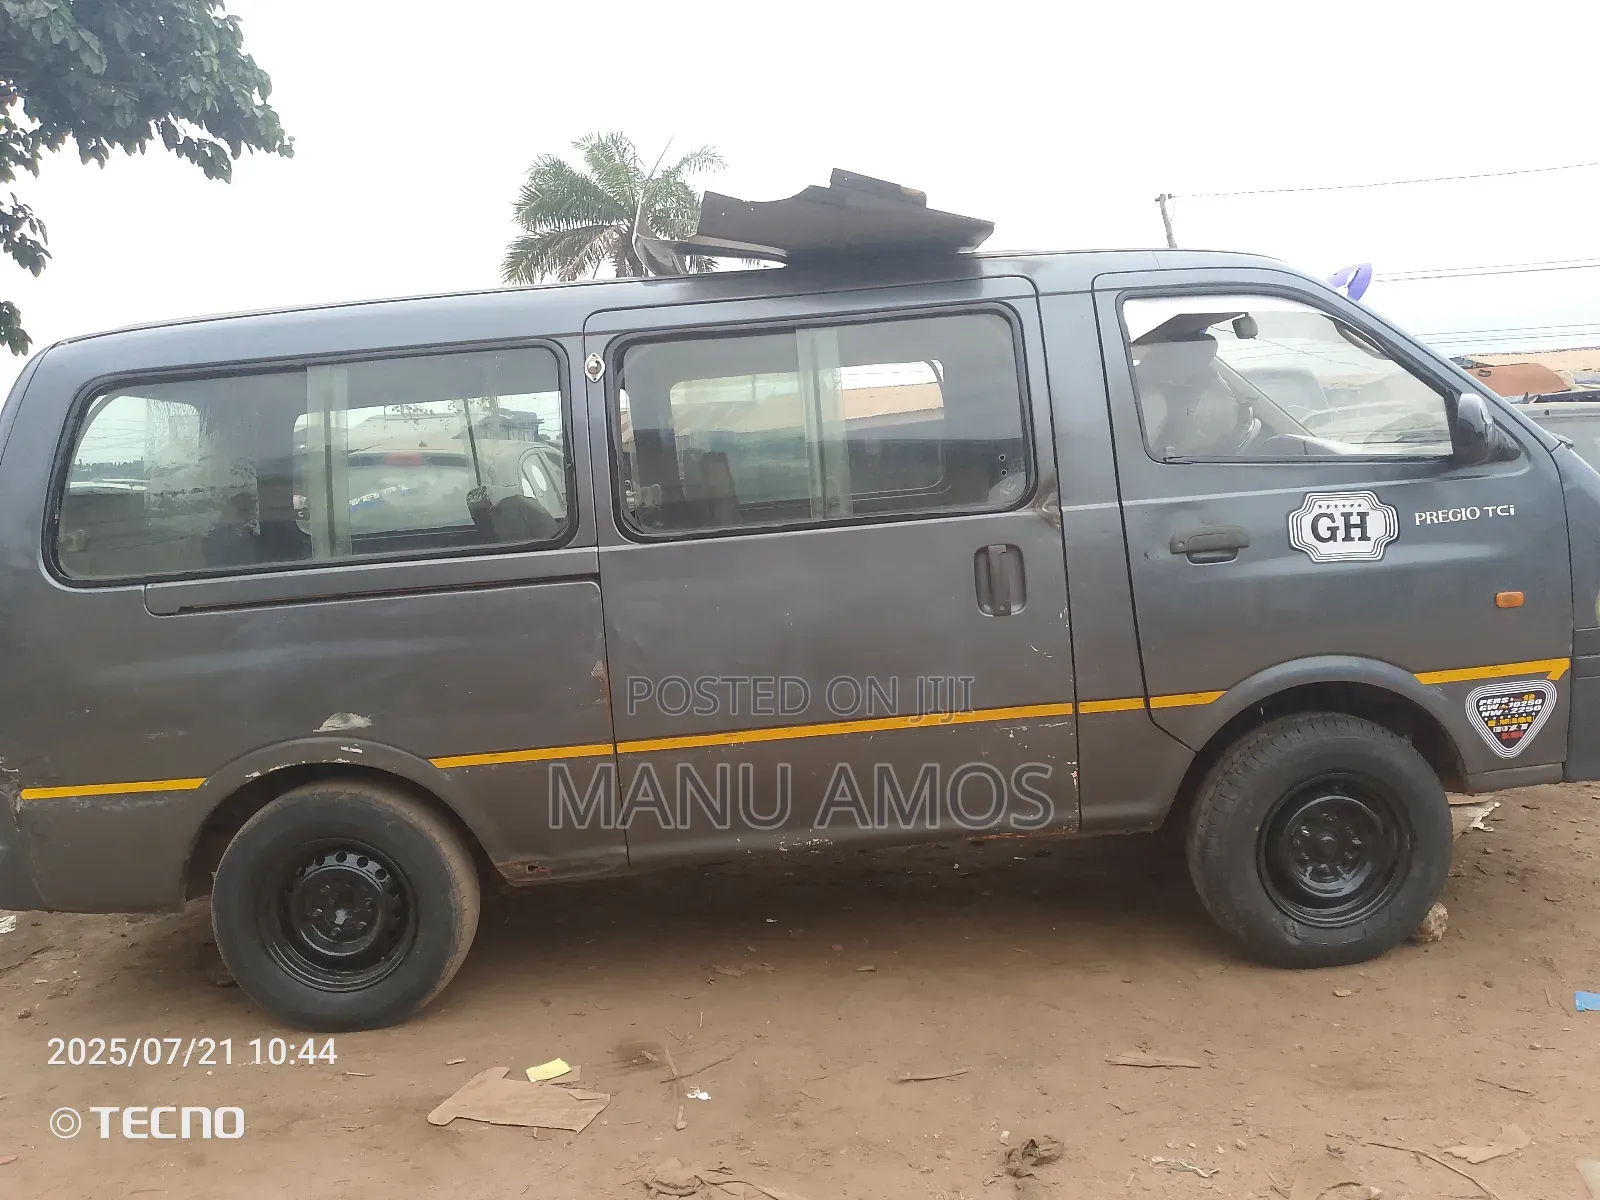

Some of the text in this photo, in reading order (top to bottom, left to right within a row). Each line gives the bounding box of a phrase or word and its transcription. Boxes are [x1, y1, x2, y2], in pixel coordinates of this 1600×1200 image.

[1310, 511, 1371, 544] GH
[1414, 504, 1516, 526] PREGIO TCi
